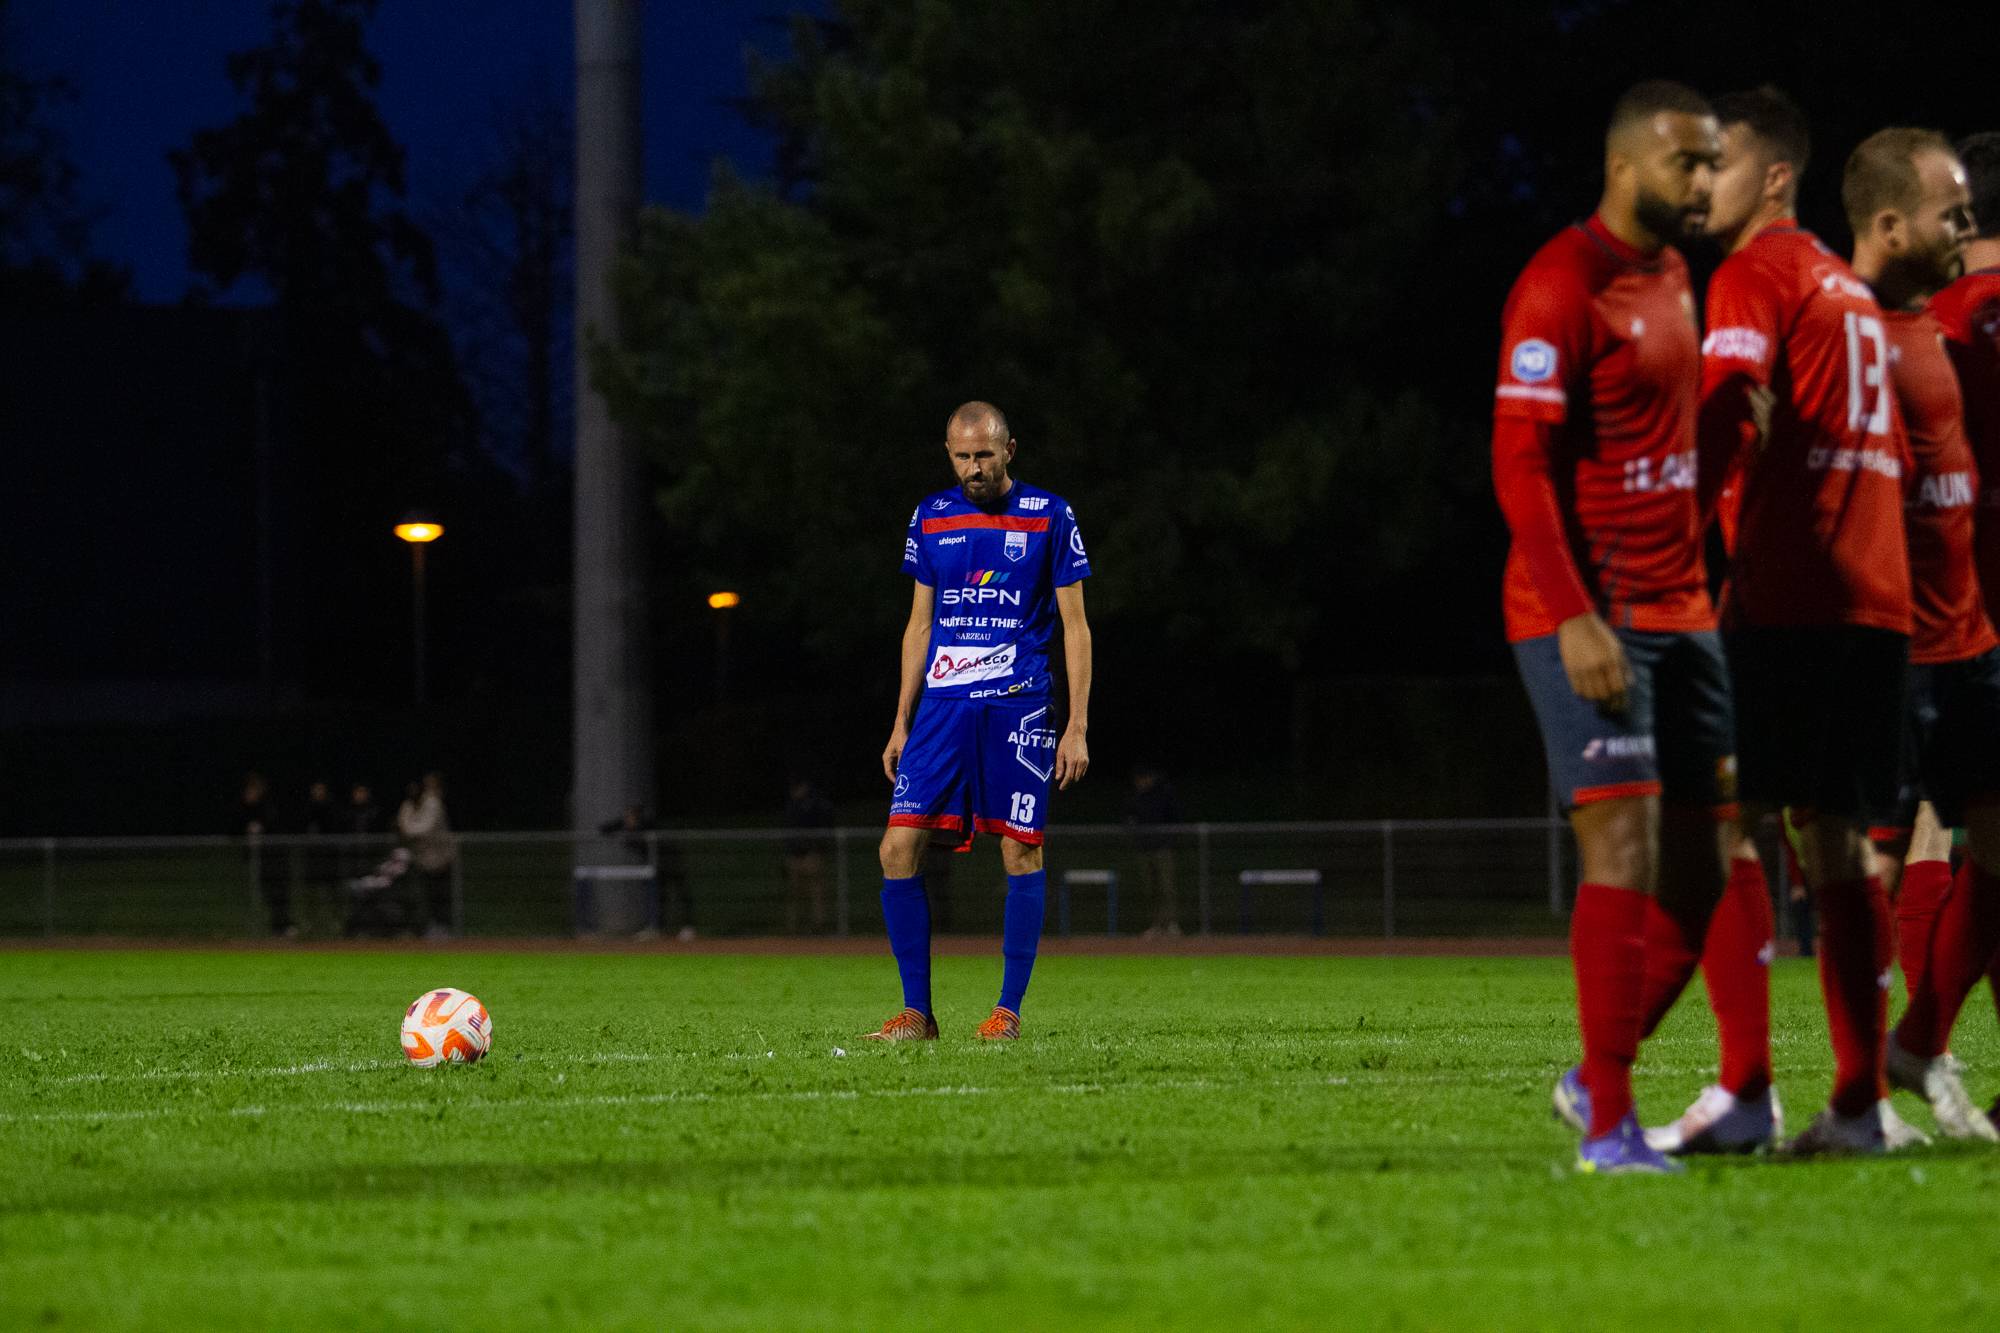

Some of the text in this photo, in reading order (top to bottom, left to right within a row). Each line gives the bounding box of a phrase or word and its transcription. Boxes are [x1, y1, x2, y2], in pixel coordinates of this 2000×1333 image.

[1843, 310, 1891, 436] 13
[938, 535, 967, 546] uhlsport
[942, 588, 1021, 606] SRPN
[975, 617, 988, 627] LE
[955, 632, 992, 641] SARZEAU
[1010, 791, 1036, 824] 13
